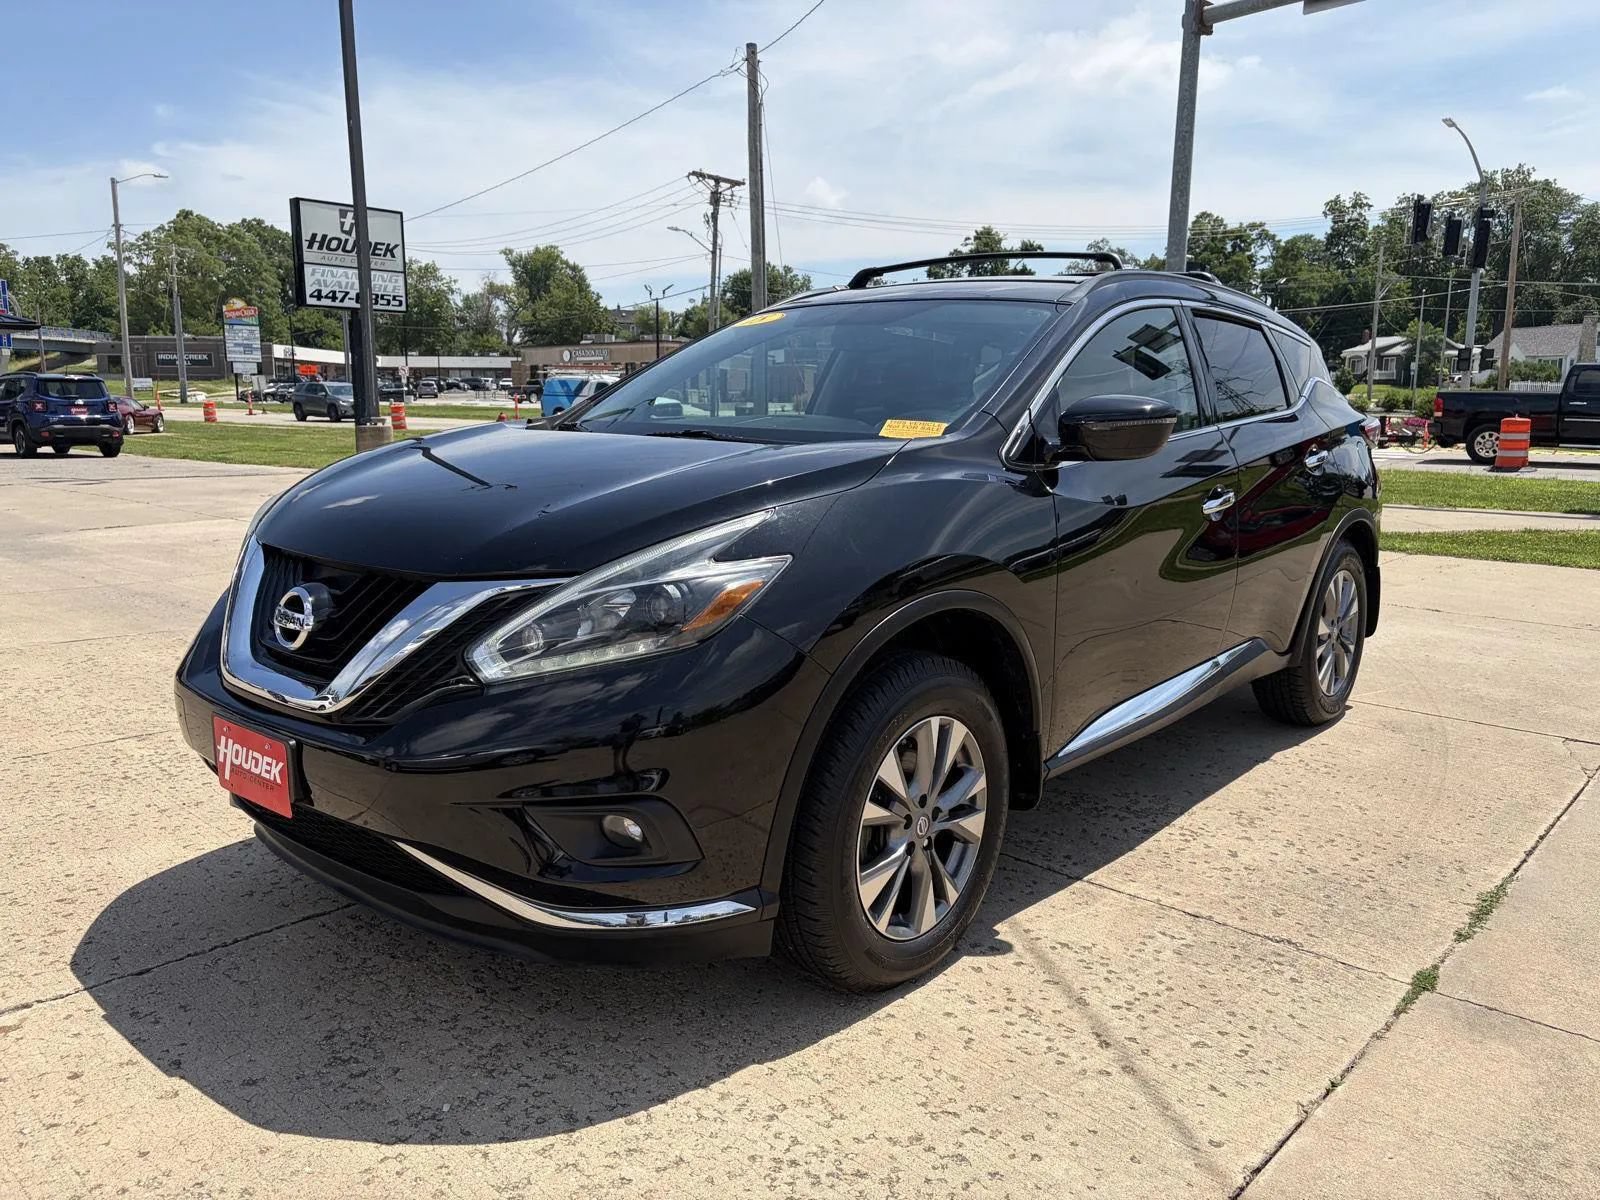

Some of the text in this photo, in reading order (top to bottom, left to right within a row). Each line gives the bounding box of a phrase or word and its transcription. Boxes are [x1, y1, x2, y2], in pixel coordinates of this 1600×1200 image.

[305, 233, 400, 258] HOUEK
[321, 255, 346, 263] AUTO
[310, 268, 400, 284] FINANING
[310, 279, 401, 293] AVAILBLE
[217, 735, 285, 784] HOUDEK
[231, 767, 274, 792] AUTO CENTER
